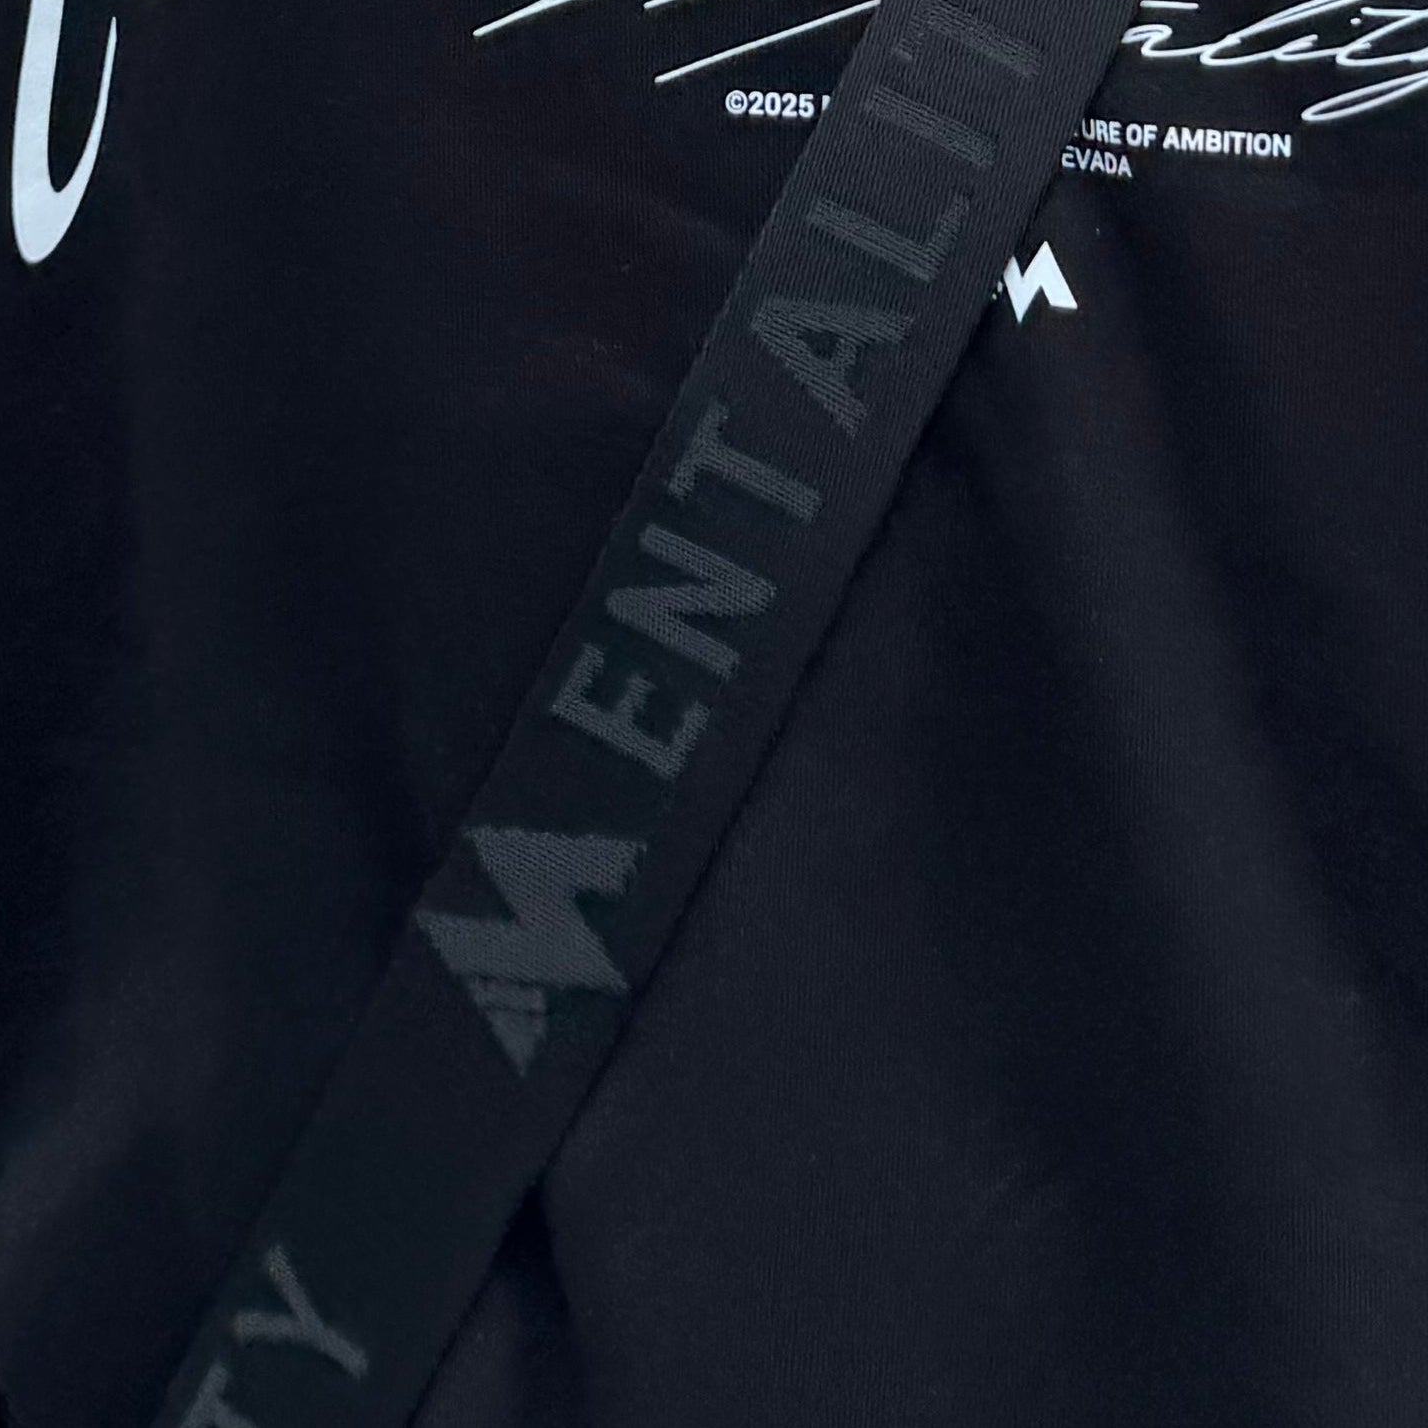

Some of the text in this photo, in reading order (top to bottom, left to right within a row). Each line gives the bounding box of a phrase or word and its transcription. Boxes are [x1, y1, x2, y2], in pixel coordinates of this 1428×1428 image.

[1125, 123, 1158, 148] OF
[1162, 126, 1292, 158] AMBITION
[1061, 145, 1132, 178] EVADA
